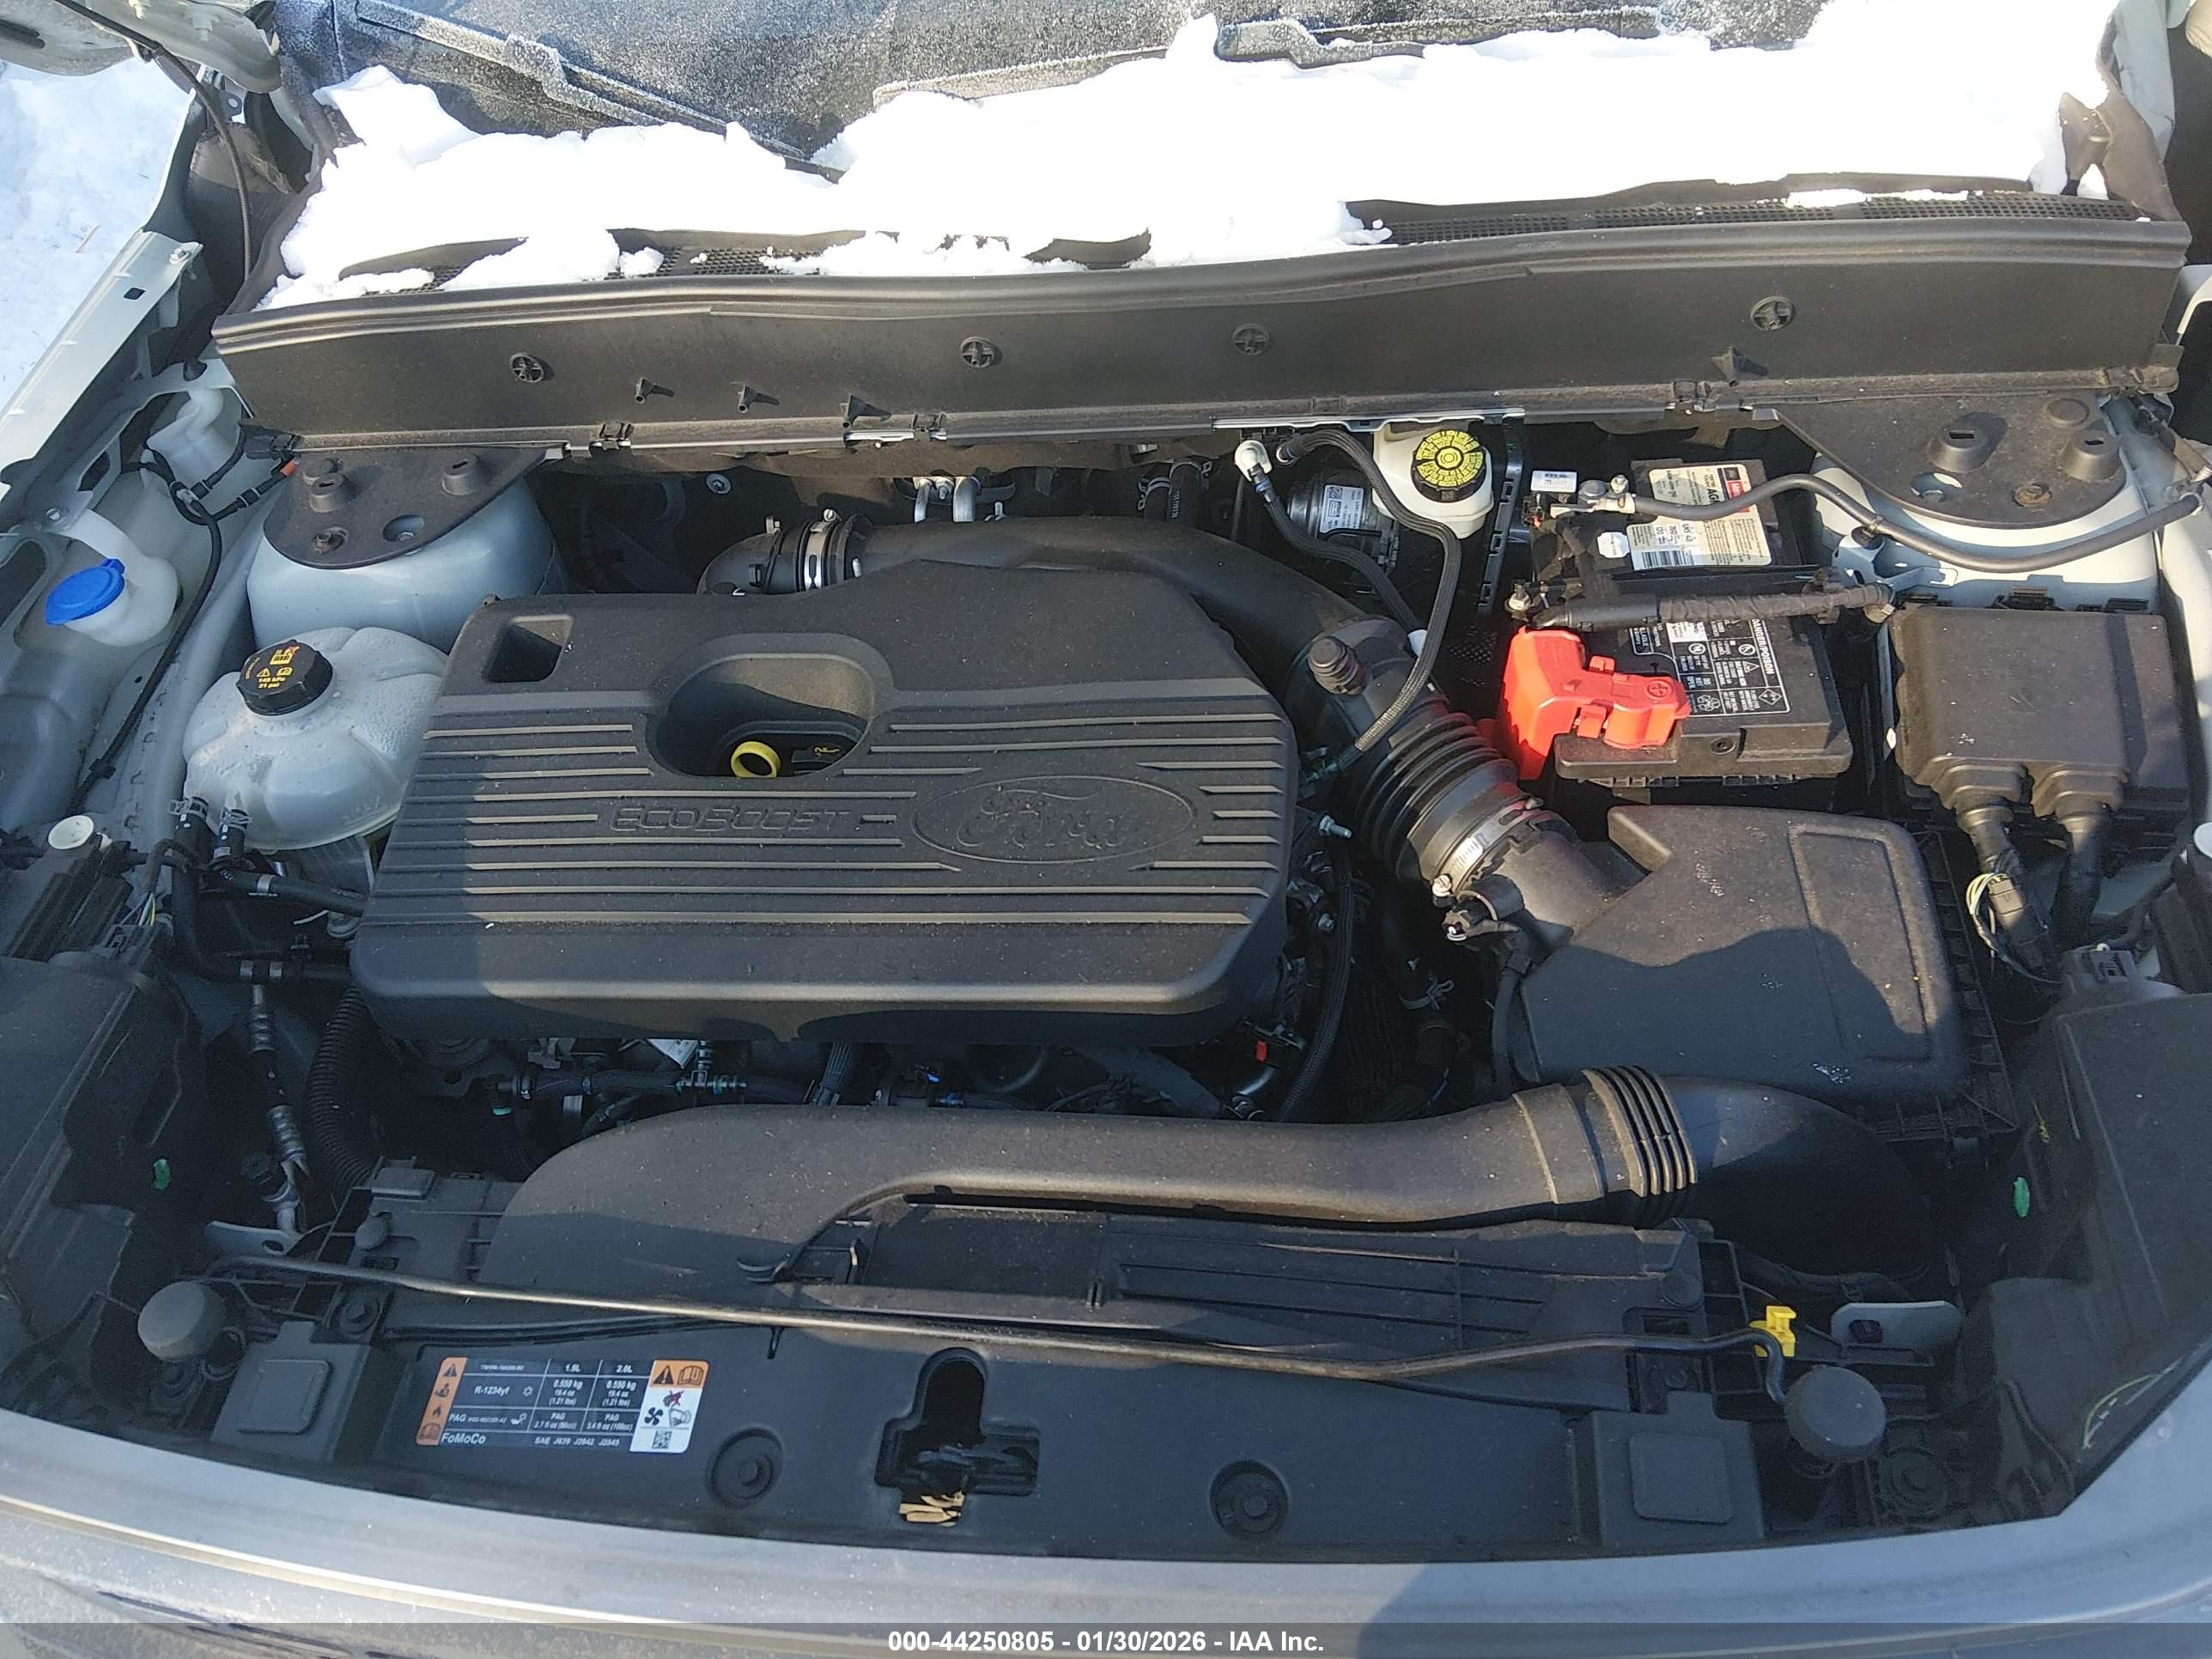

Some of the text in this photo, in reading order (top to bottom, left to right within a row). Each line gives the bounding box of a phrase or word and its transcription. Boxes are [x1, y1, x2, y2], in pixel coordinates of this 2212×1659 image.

[1752, 618, 1775, 675] DANGER/POISON
[1695, 677, 1704, 688] NOT
[610, 805, 851, 832] ECOBOOST
[616, 1364, 633, 1374] 2.0L
[553, 1379, 584, 1390] 0.550 kg
[605, 1379, 637, 1391] 0.550 kg
[473, 1385, 511, 1397] R-1234yf
[448, 1413, 466, 1422] PAG
[441, 1432, 487, 1444] FoMoCo
